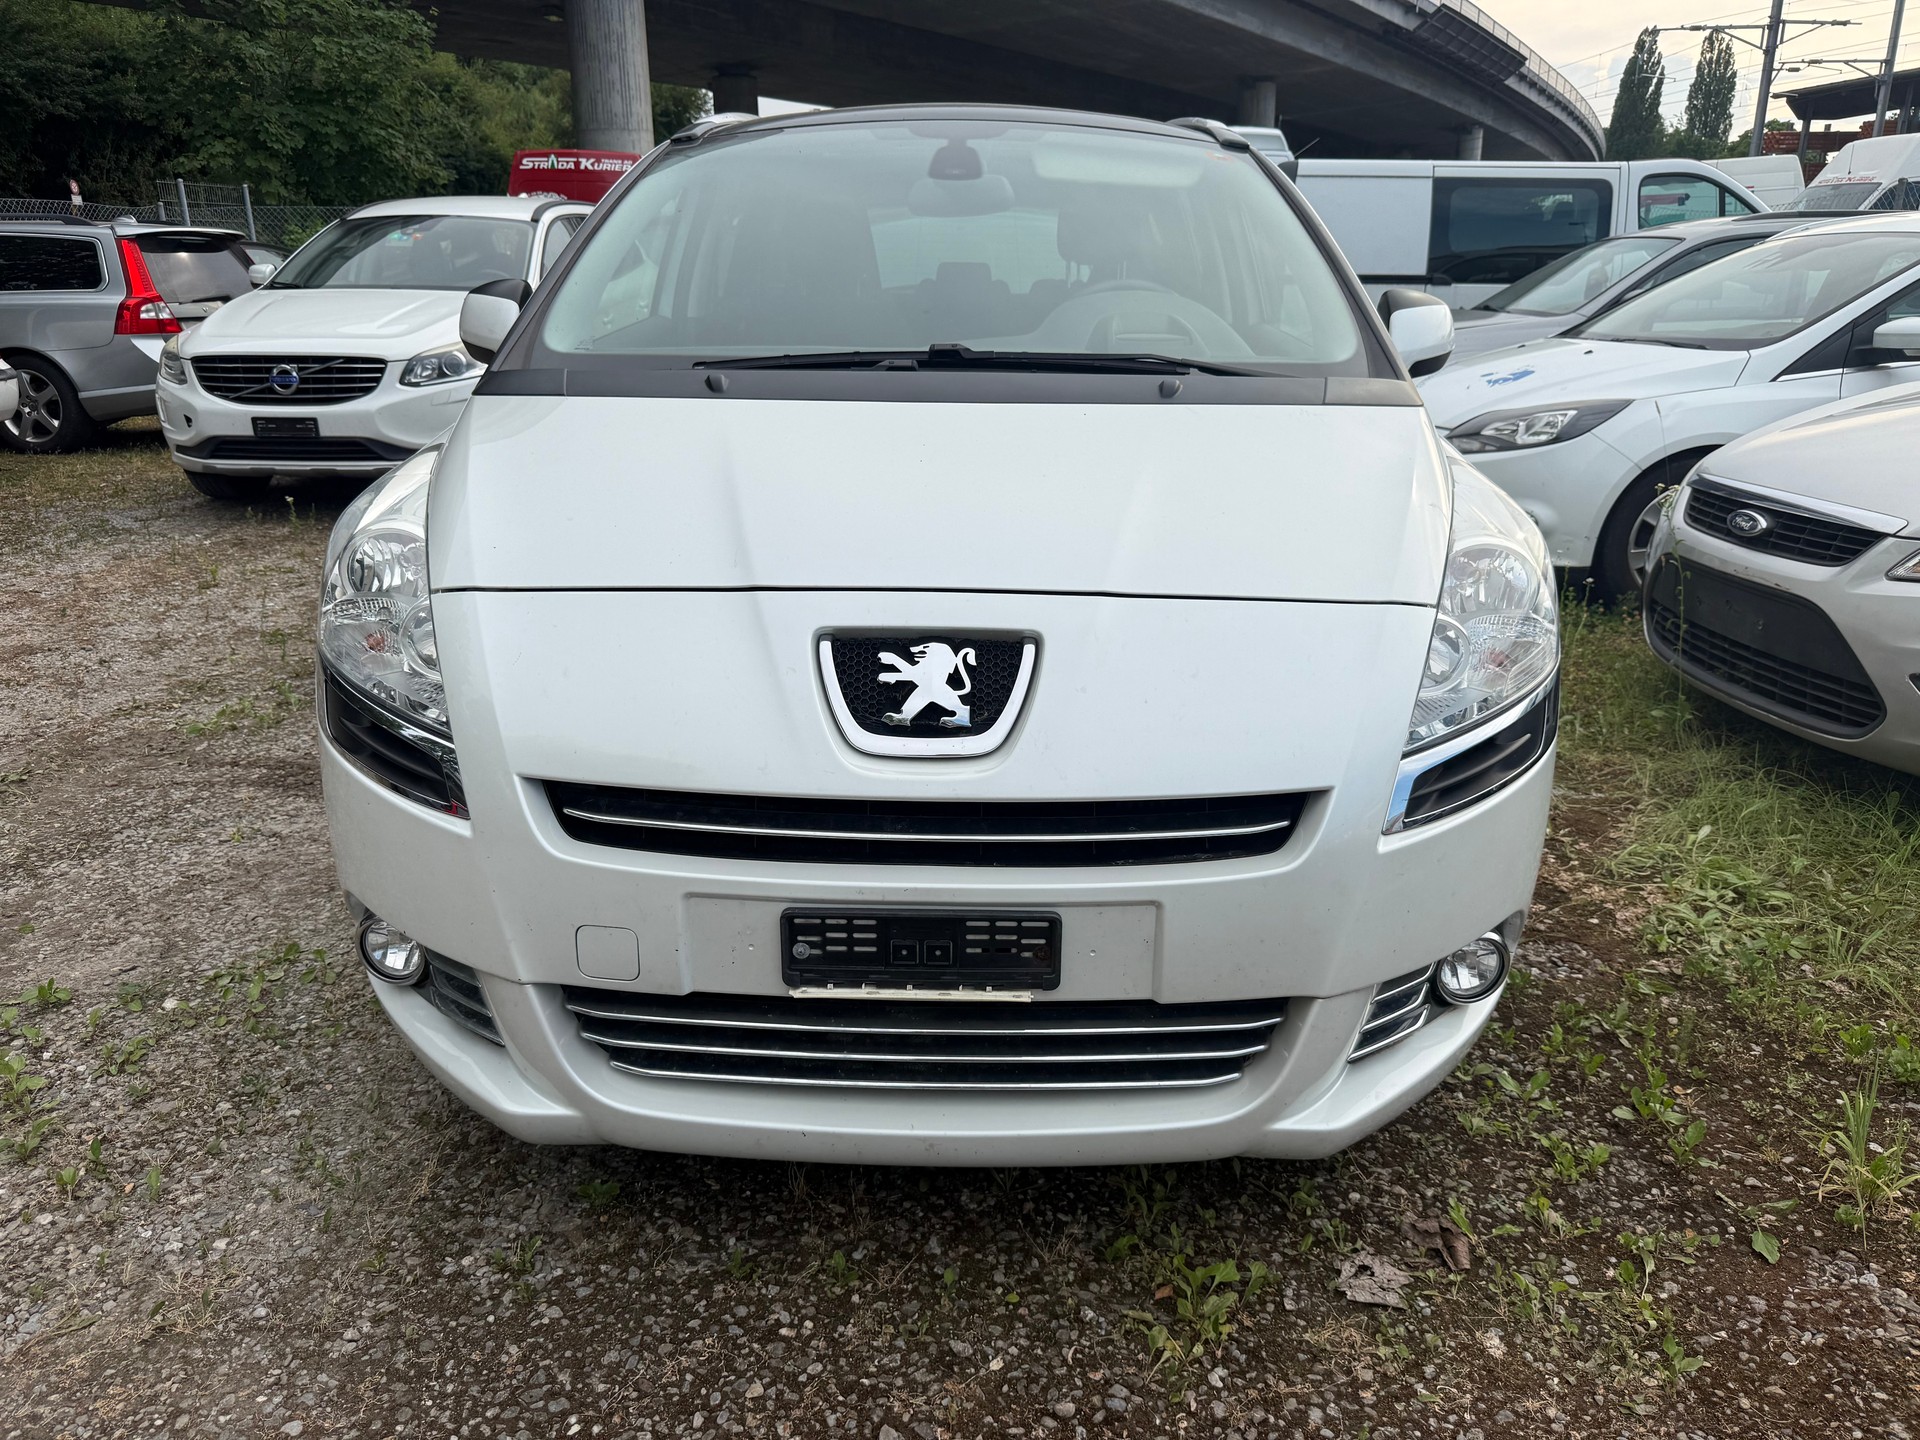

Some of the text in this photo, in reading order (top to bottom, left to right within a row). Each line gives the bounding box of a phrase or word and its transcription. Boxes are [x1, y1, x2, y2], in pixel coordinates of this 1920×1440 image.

[519, 154, 632, 172] STRADA KURIER
[1732, 514, 1754, 530] Ford
